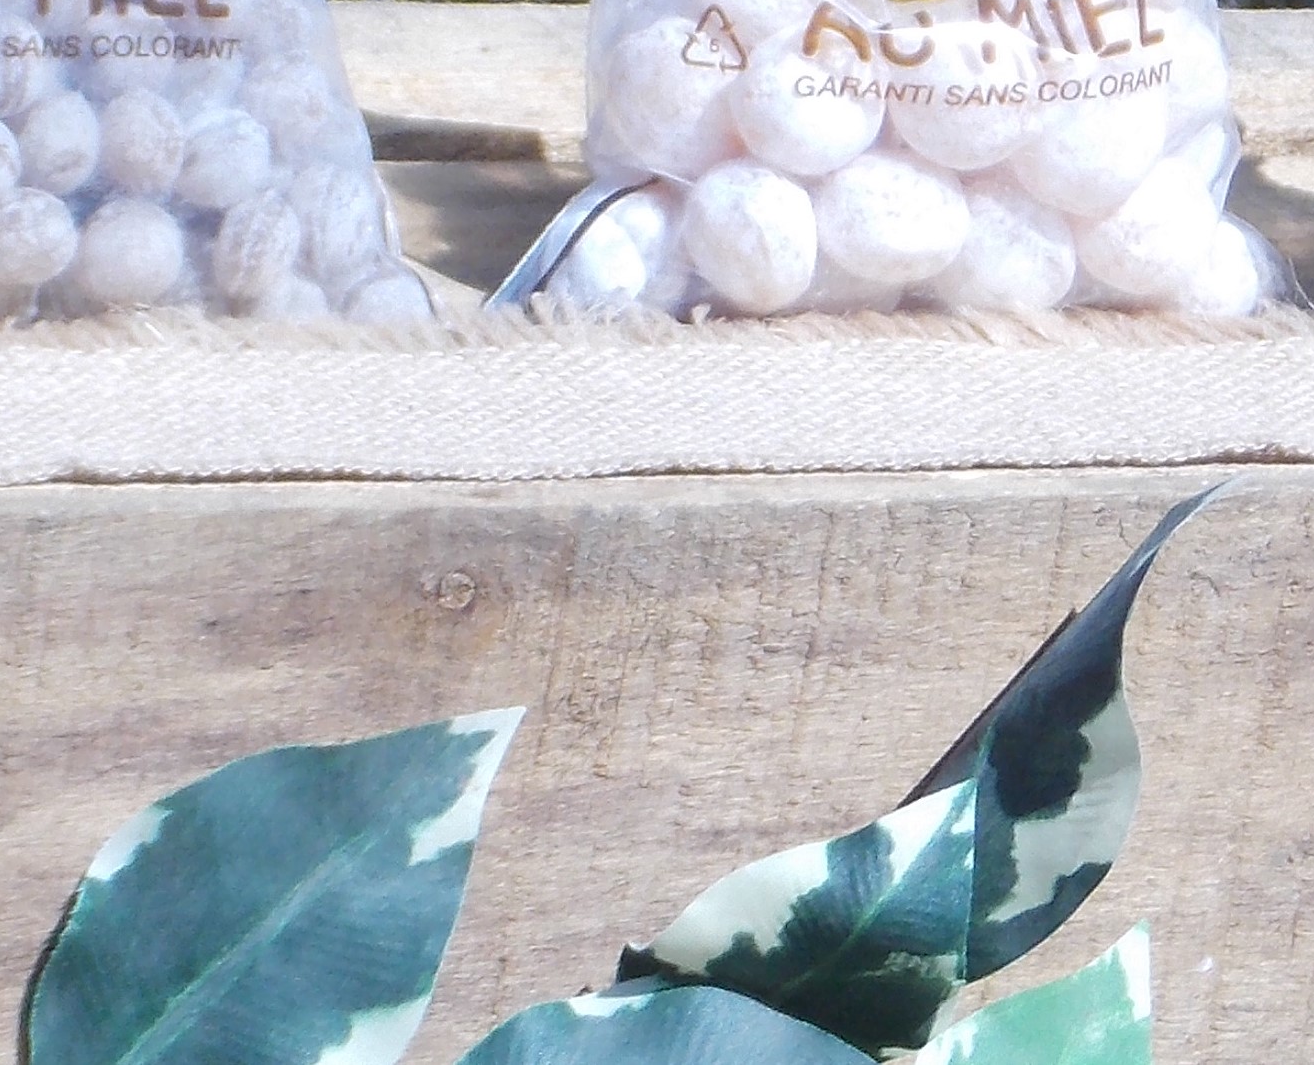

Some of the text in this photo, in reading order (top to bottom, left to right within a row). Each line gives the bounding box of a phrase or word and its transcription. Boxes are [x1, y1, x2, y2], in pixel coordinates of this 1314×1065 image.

[2, 35, 82, 60] SANS
[89, 35, 244, 61] COLORANT
[801, 0, 936, 68] AU
[794, 59, 1174, 106] GARANTI SANS COLORANT
